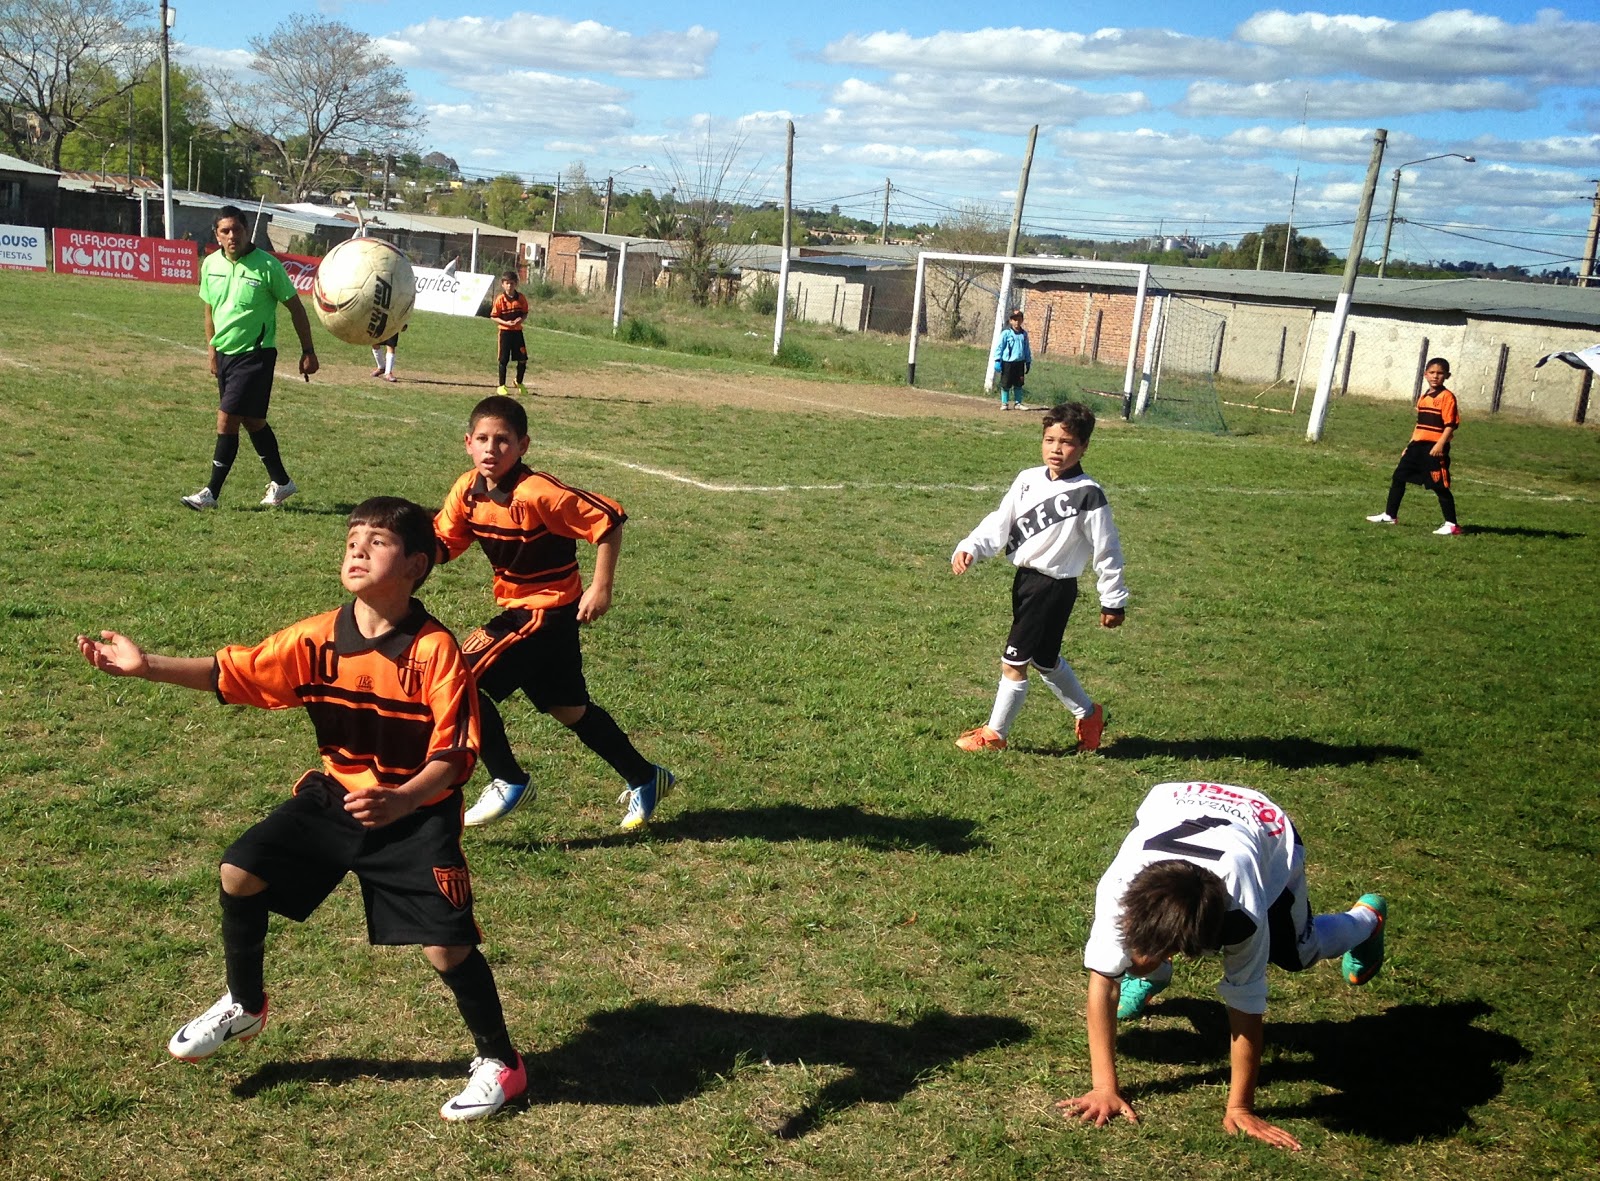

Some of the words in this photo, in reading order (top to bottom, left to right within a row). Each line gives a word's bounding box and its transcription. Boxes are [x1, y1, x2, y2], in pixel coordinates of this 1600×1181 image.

[0, 234, 38, 248] ouse
[70, 233, 139, 249] ALFAJORES
[176, 259, 191, 268] 473
[161, 267, 192, 279] 38882
[415, 275, 460, 294] gritec
[304, 637, 339, 684] 10
[1142, 814, 1232, 862] 7
